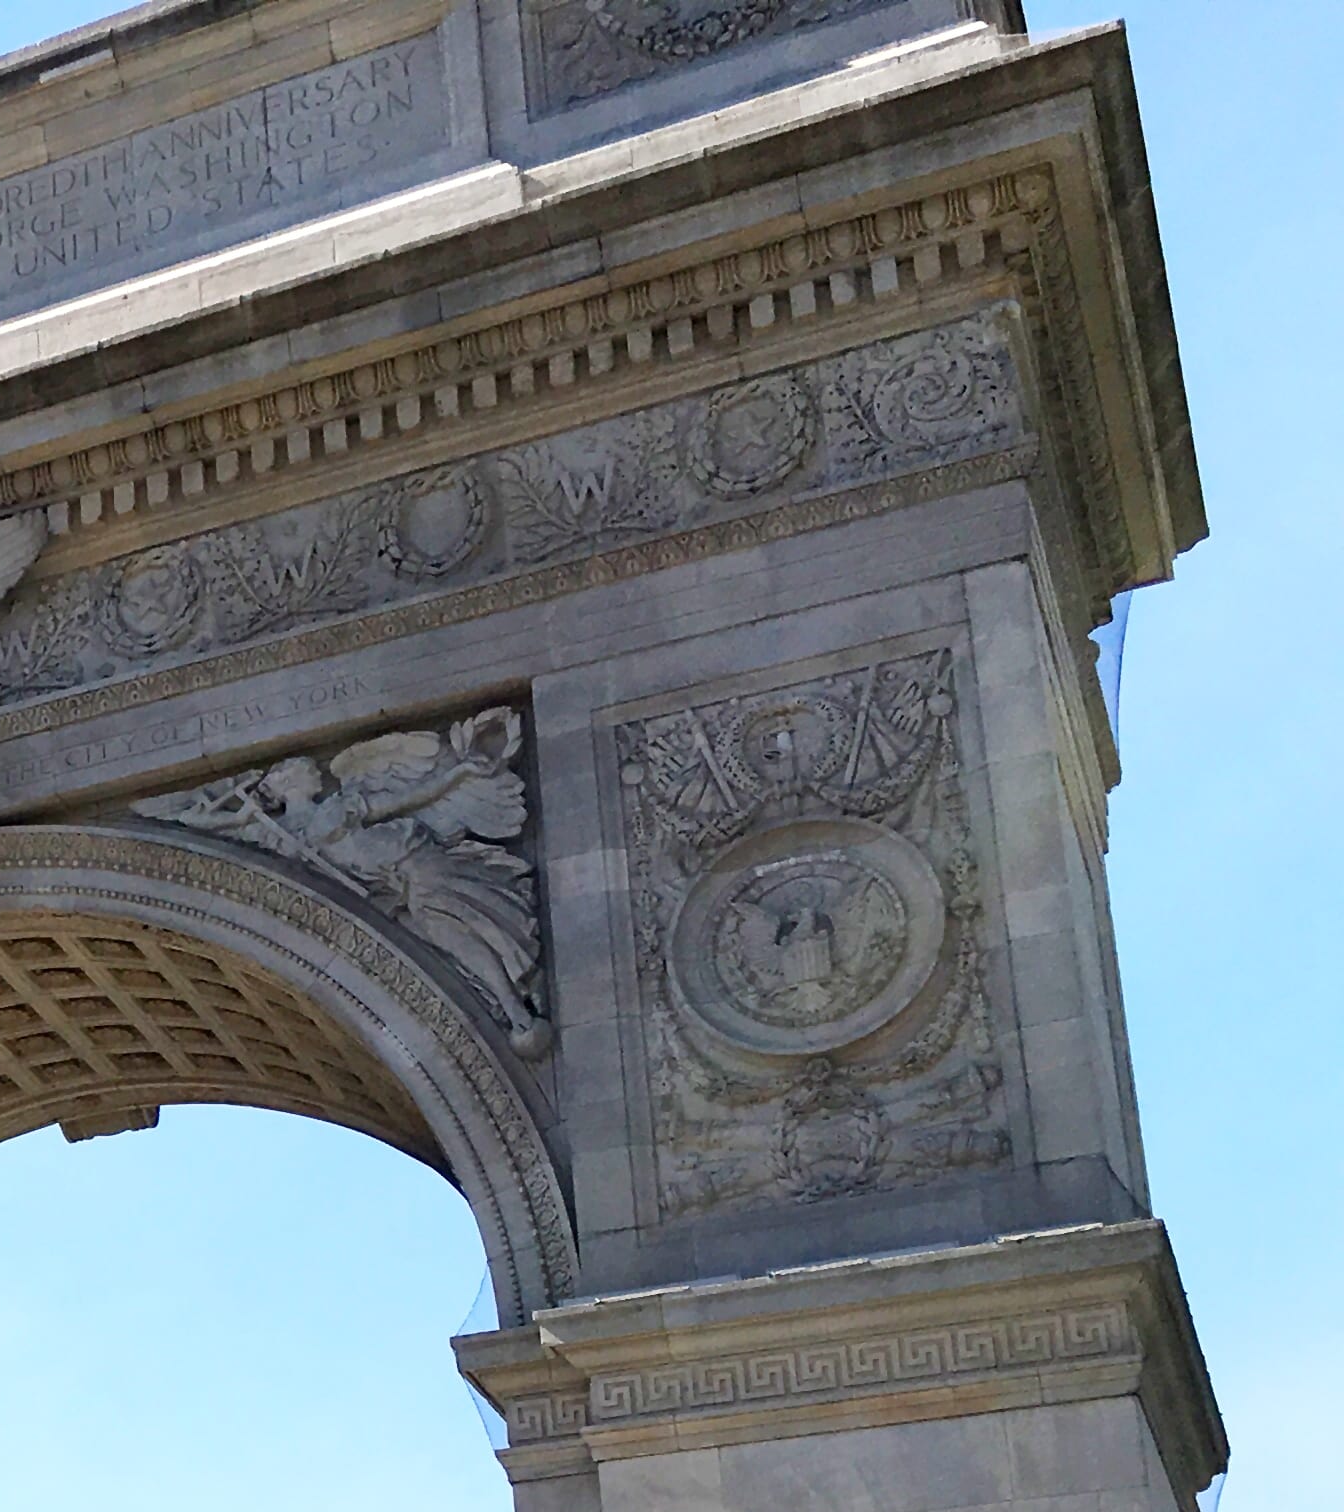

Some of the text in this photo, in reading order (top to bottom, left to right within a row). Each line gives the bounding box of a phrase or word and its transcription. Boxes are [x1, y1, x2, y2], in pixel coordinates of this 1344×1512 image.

[103, 83, 414, 211] WASHINGTON
[138, 49, 416, 167] ANNIVERSARY
[14, 202, 173, 277] UNITED
[552, 459, 614, 515] W
[0, 757, 52, 785] THE
[64, 733, 138, 767] CITY
[199, 704, 271, 732] NEW
[288, 676, 370, 710] YORK
